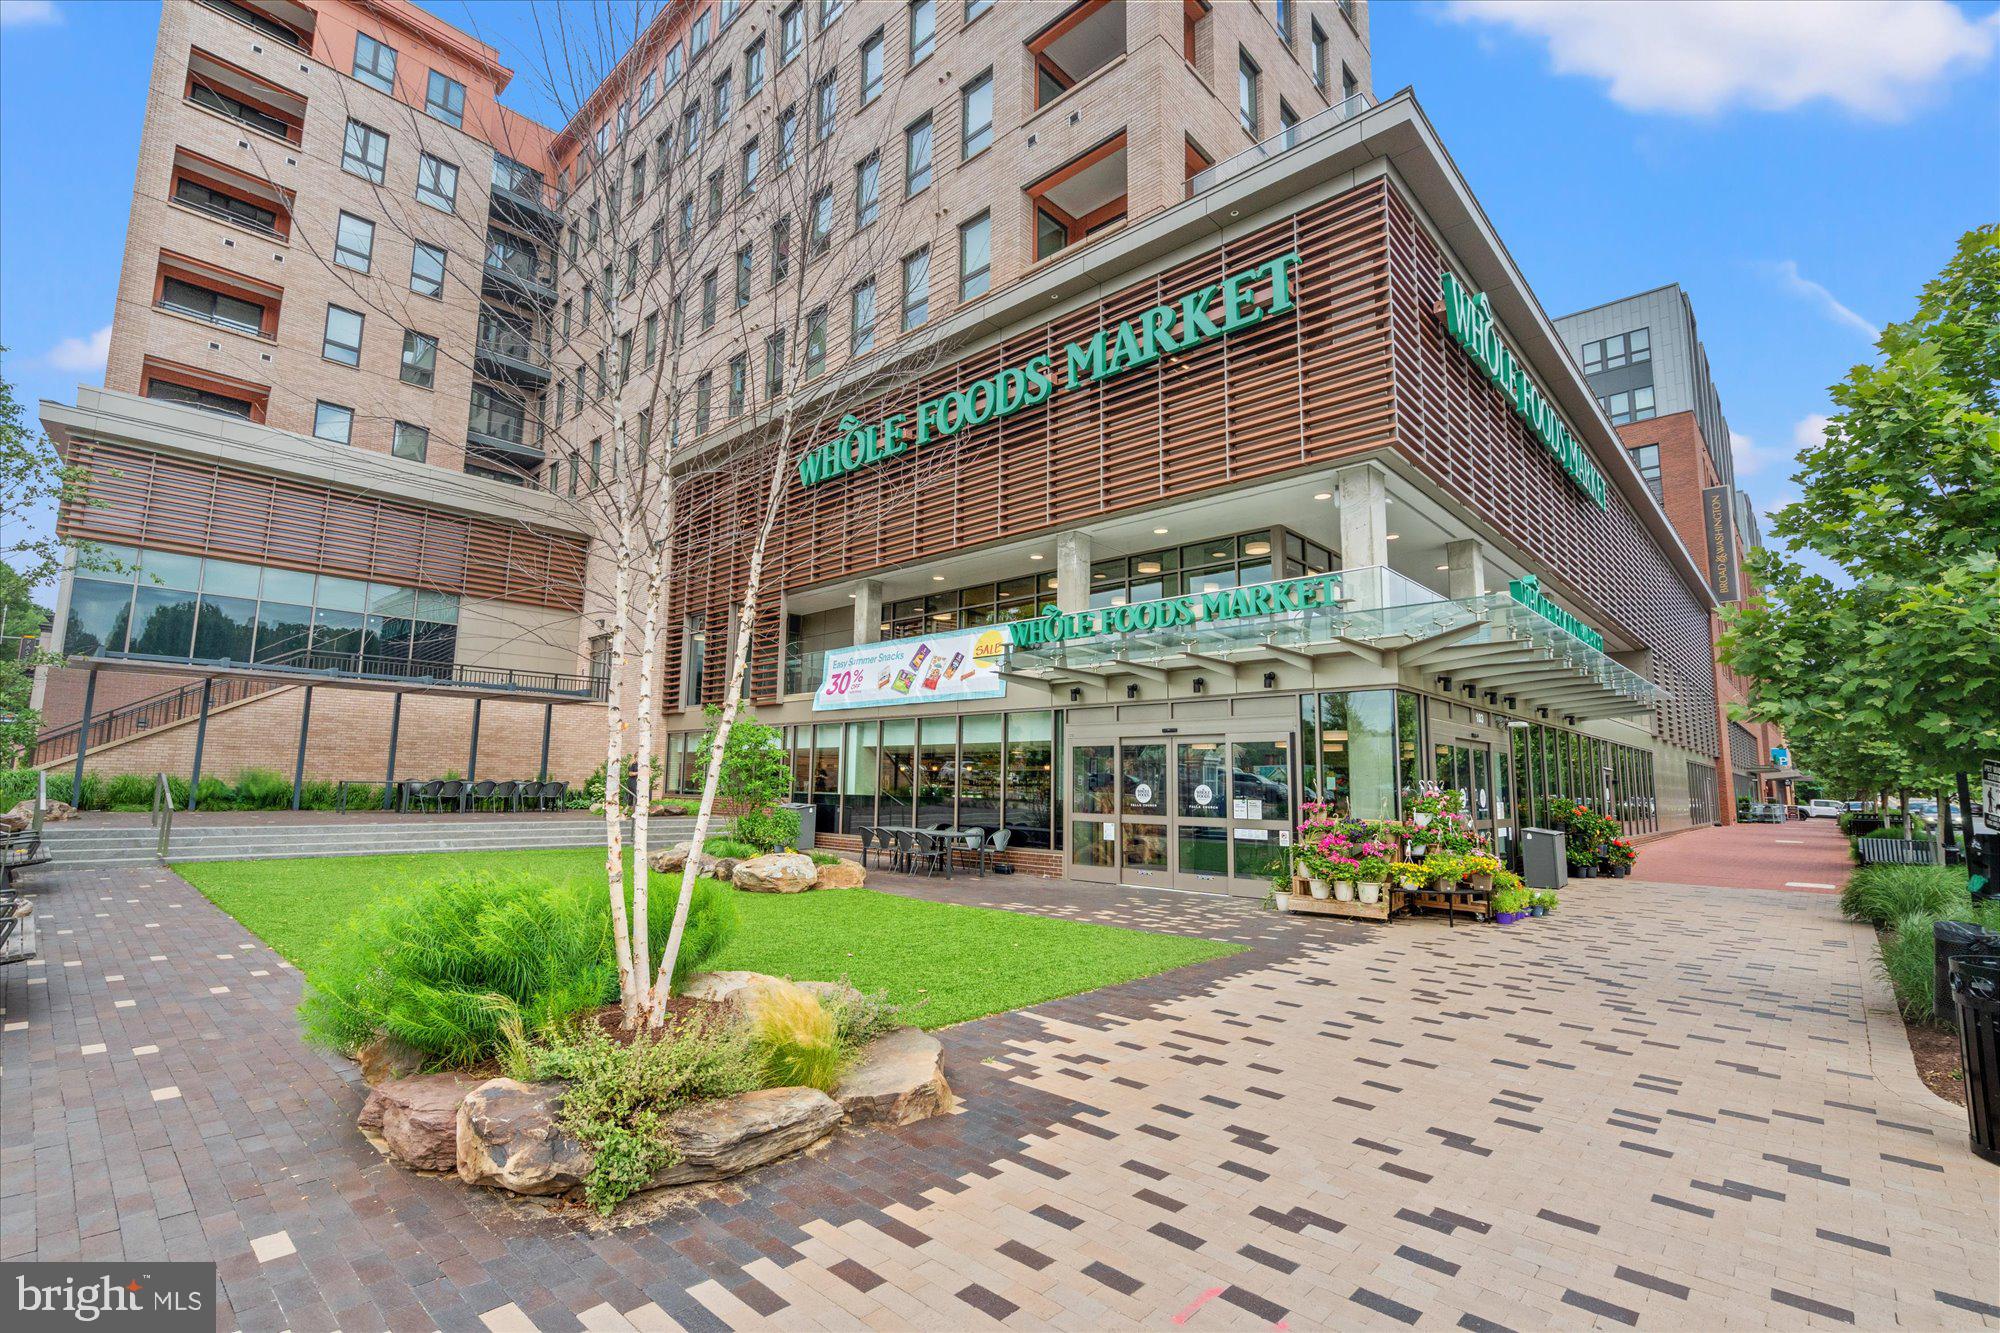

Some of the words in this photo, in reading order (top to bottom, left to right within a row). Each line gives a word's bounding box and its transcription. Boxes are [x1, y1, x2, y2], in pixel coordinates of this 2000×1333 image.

[799, 413, 907, 487] WHOLE
[915, 354, 1052, 445] FOODS
[1064, 251, 1302, 390] MARKET
[1515, 370, 1566, 463] FOODS
[1563, 431, 1606, 512] MARKET
[1712, 495, 1725, 554] WASHINGTON
[1718, 563, 1728, 593] BROAD
[1008, 604, 1095, 647] WHOLE
[1101, 598, 1195, 634] FOODS
[1201, 575, 1342, 622] MARKET
[832, 660, 848, 669] Easy
[848, 657, 877, 667] Summer
[878, 651, 905, 662] Snacks
[976, 642, 1001, 656] SALE
